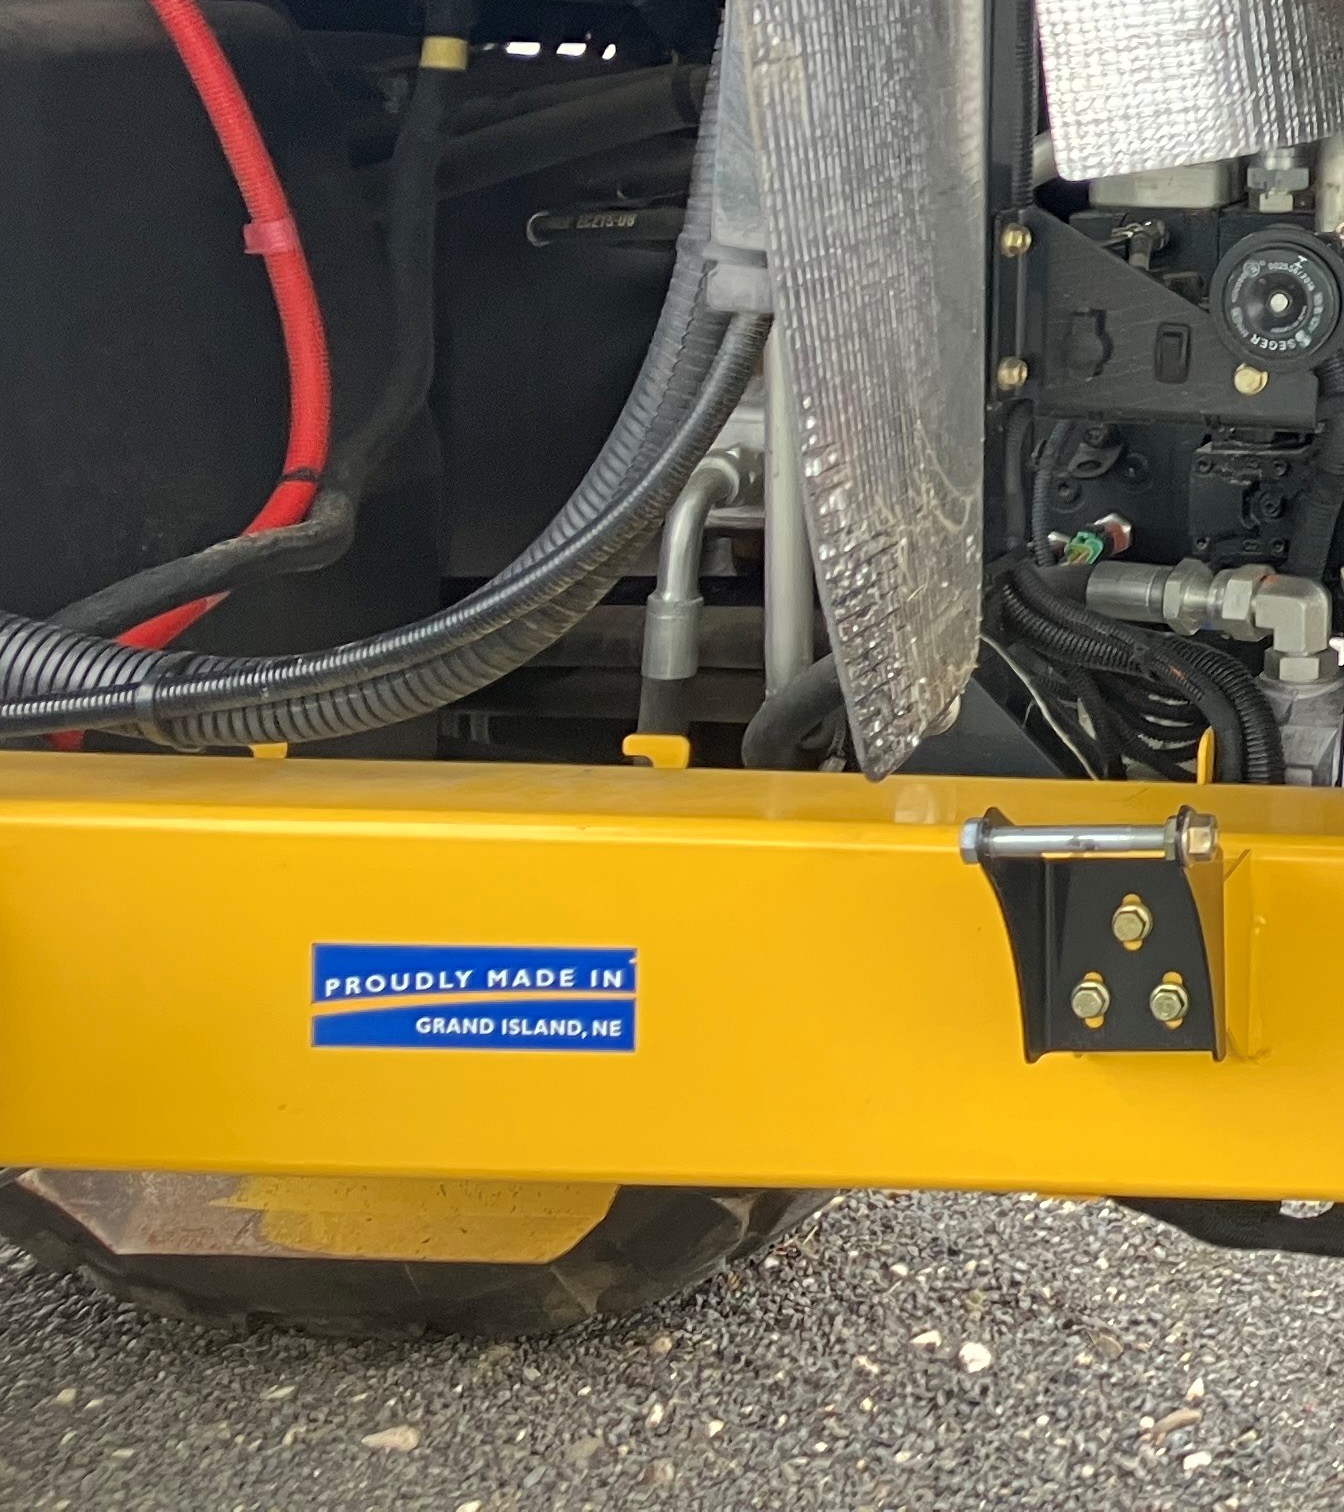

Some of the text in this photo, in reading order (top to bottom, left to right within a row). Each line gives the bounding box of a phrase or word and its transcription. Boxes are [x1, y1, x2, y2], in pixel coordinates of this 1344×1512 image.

[1250, 333, 1297, 351] SEGER
[324, 967, 624, 998] PROUDLY MADE IN
[415, 1016, 623, 1040] GRAND ISLAND, NE
